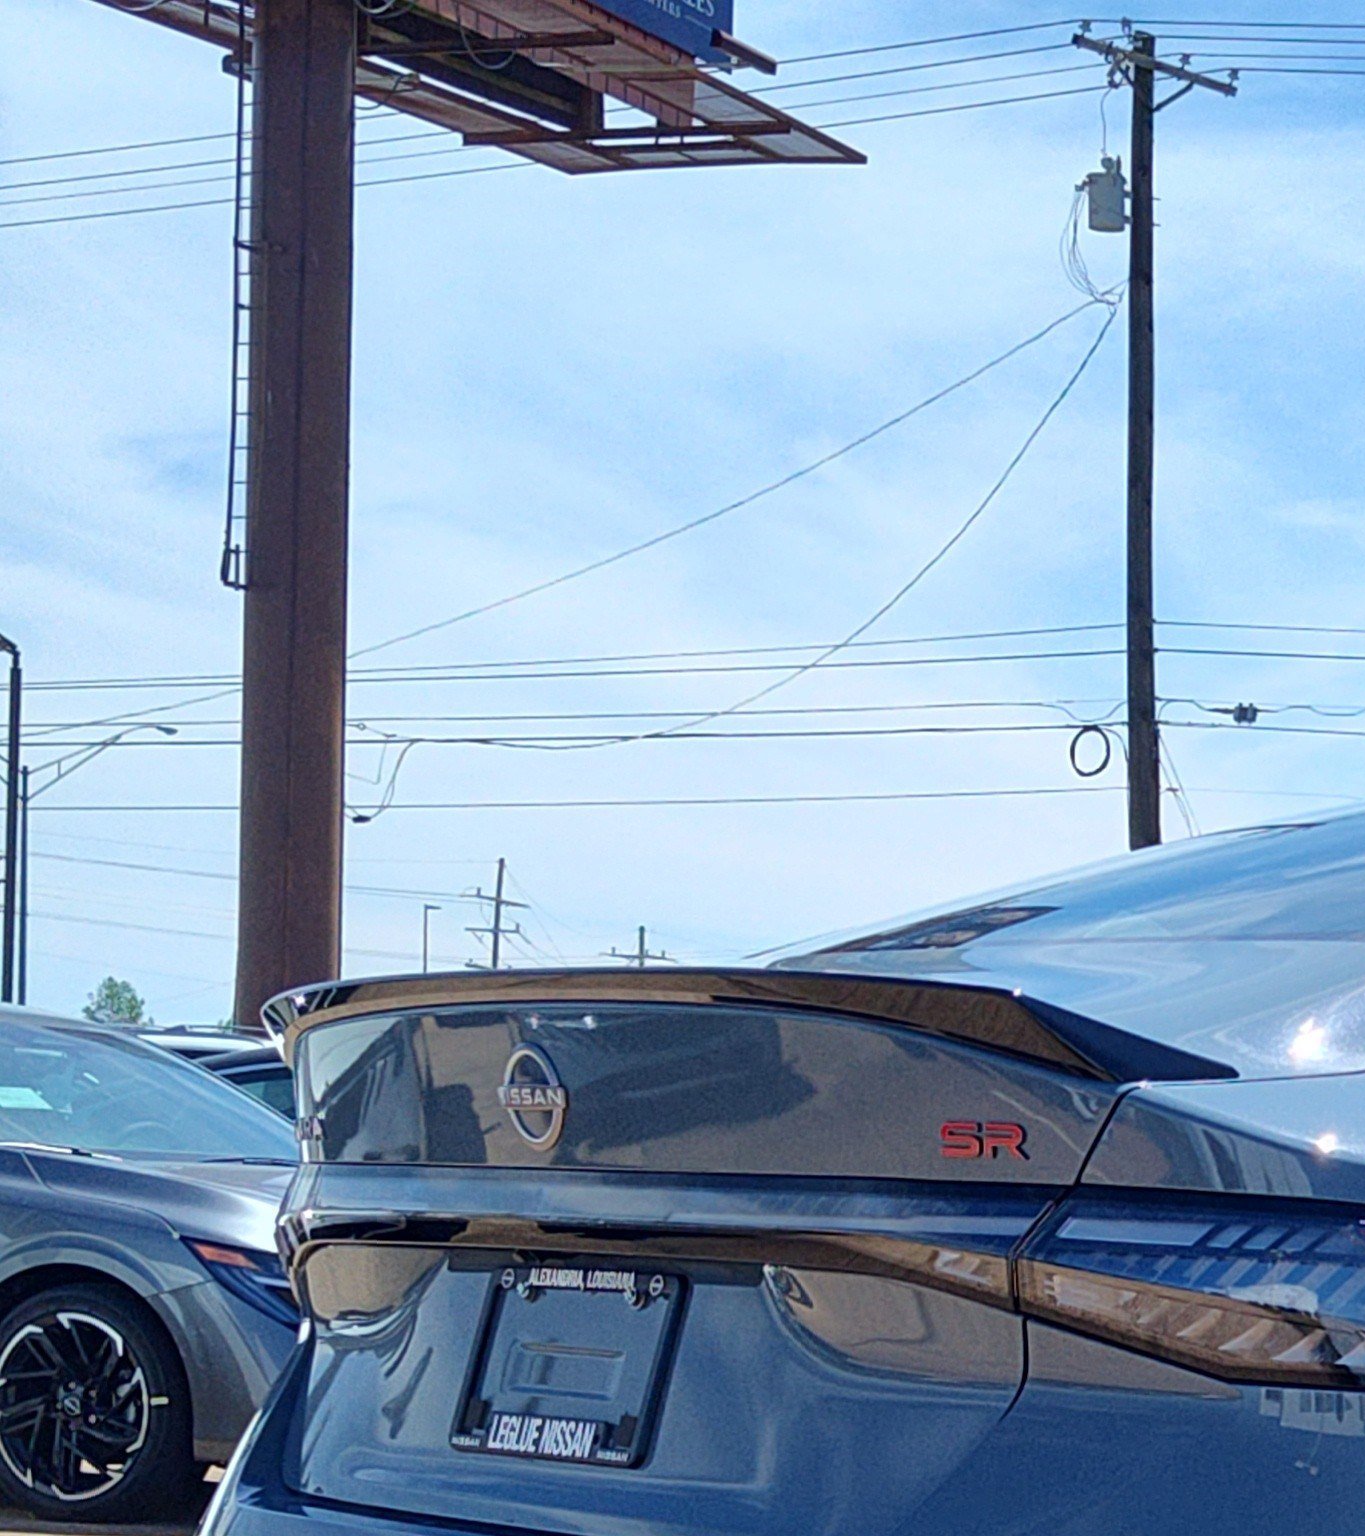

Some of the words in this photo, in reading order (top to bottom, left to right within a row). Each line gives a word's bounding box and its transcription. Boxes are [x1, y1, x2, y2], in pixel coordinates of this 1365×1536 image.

[941, 1121, 1028, 1160] SR
[529, 1267, 584, 1291] ALEXANDRIA,
[586, 1269, 635, 1290] LOUISIANA
[487, 1413, 543, 1453] LEGLUE
[539, 1418, 597, 1459] NISSAN
